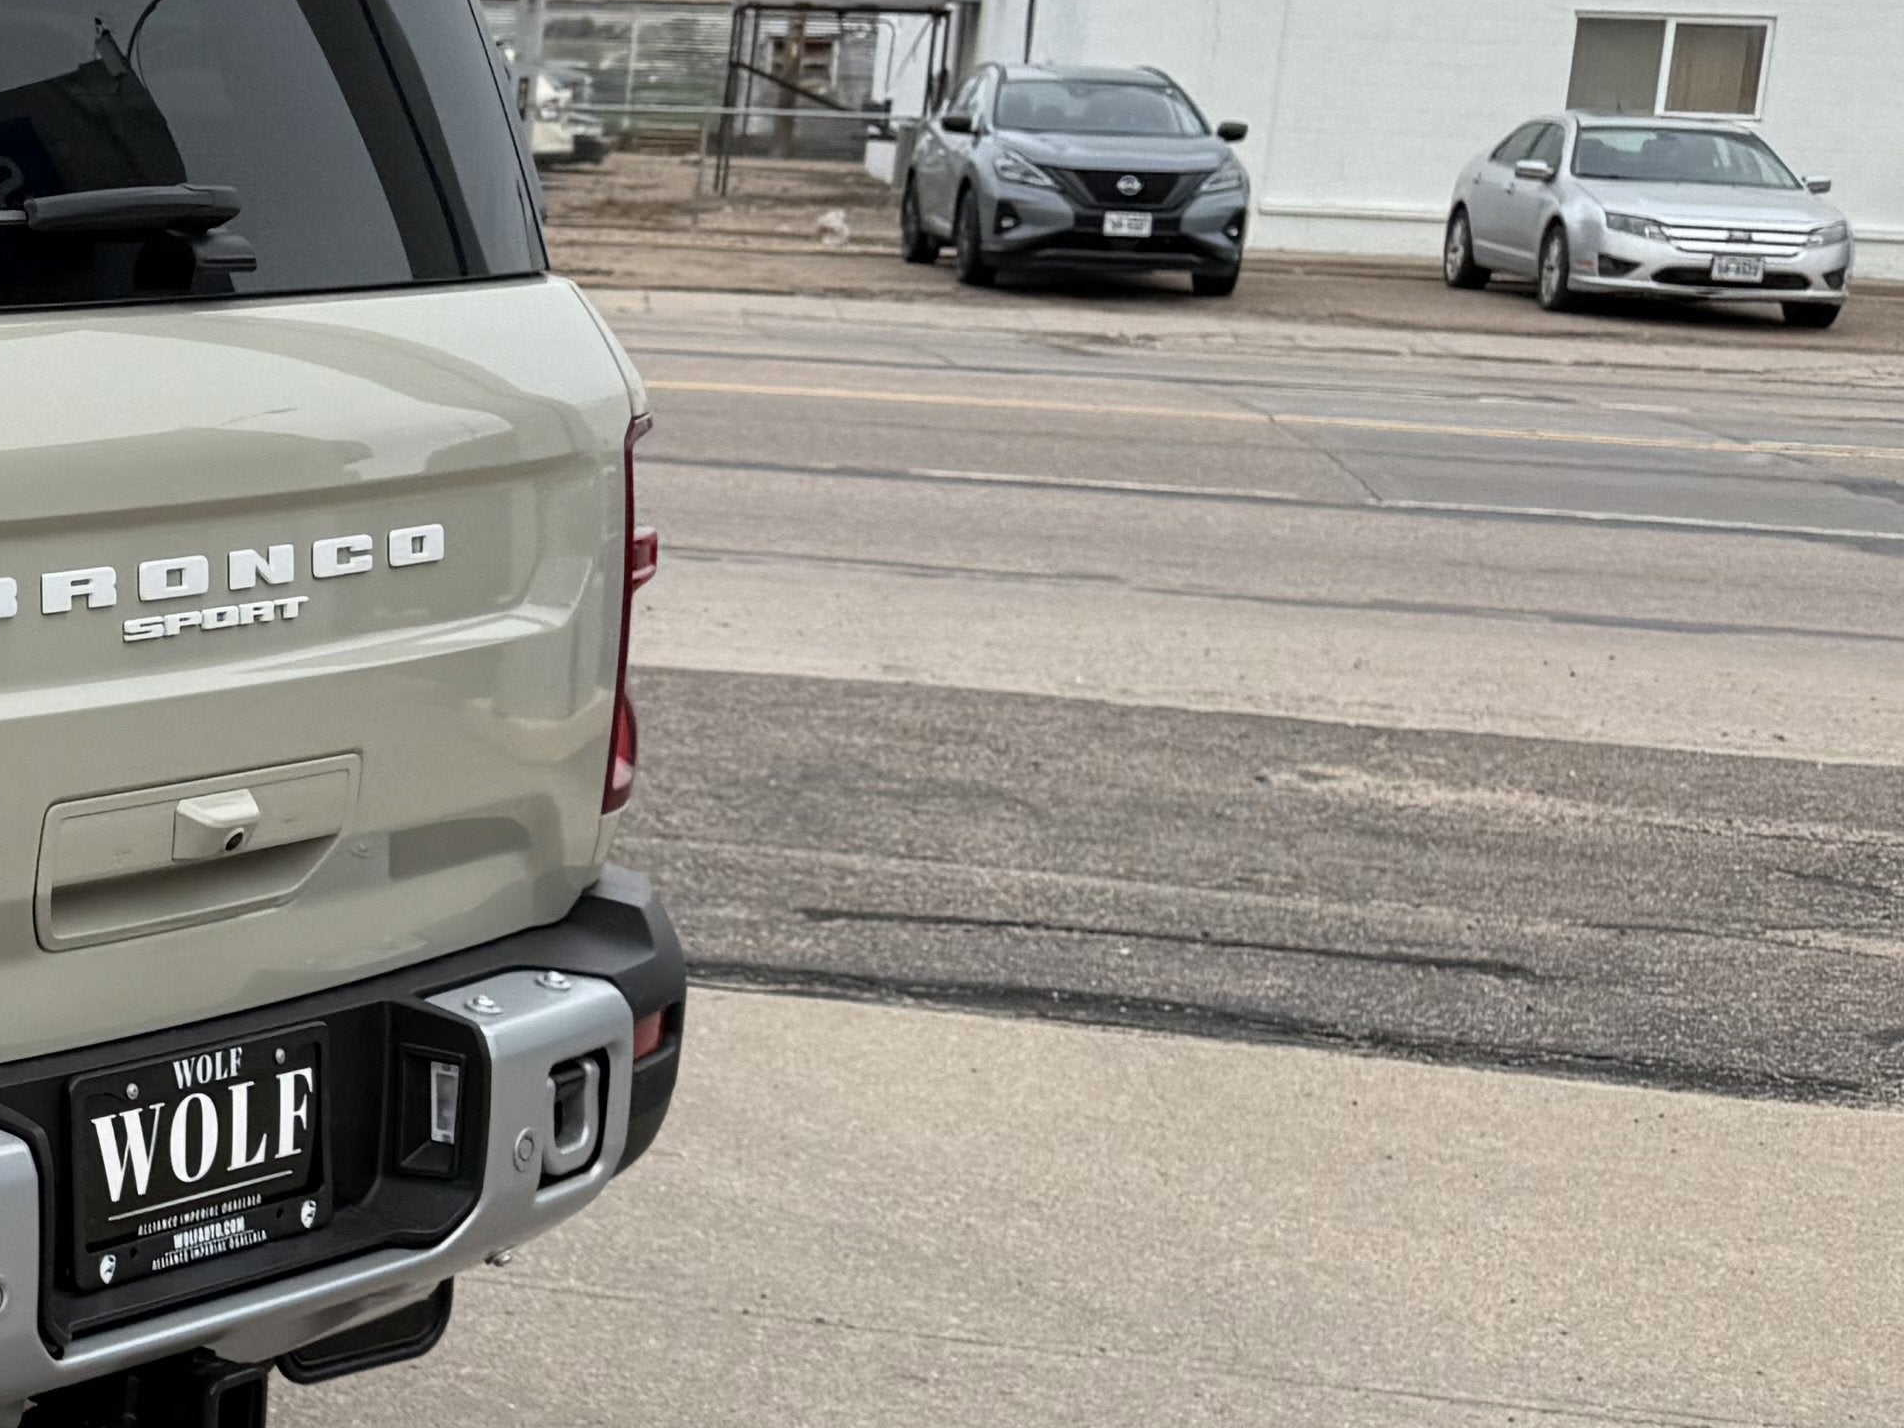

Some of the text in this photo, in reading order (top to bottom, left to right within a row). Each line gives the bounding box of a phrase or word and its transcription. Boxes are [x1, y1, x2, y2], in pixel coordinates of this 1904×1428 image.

[122, 594, 310, 643] SPORT
[173, 1046, 243, 1090] WOLF
[91, 1067, 314, 1203] WOLF
